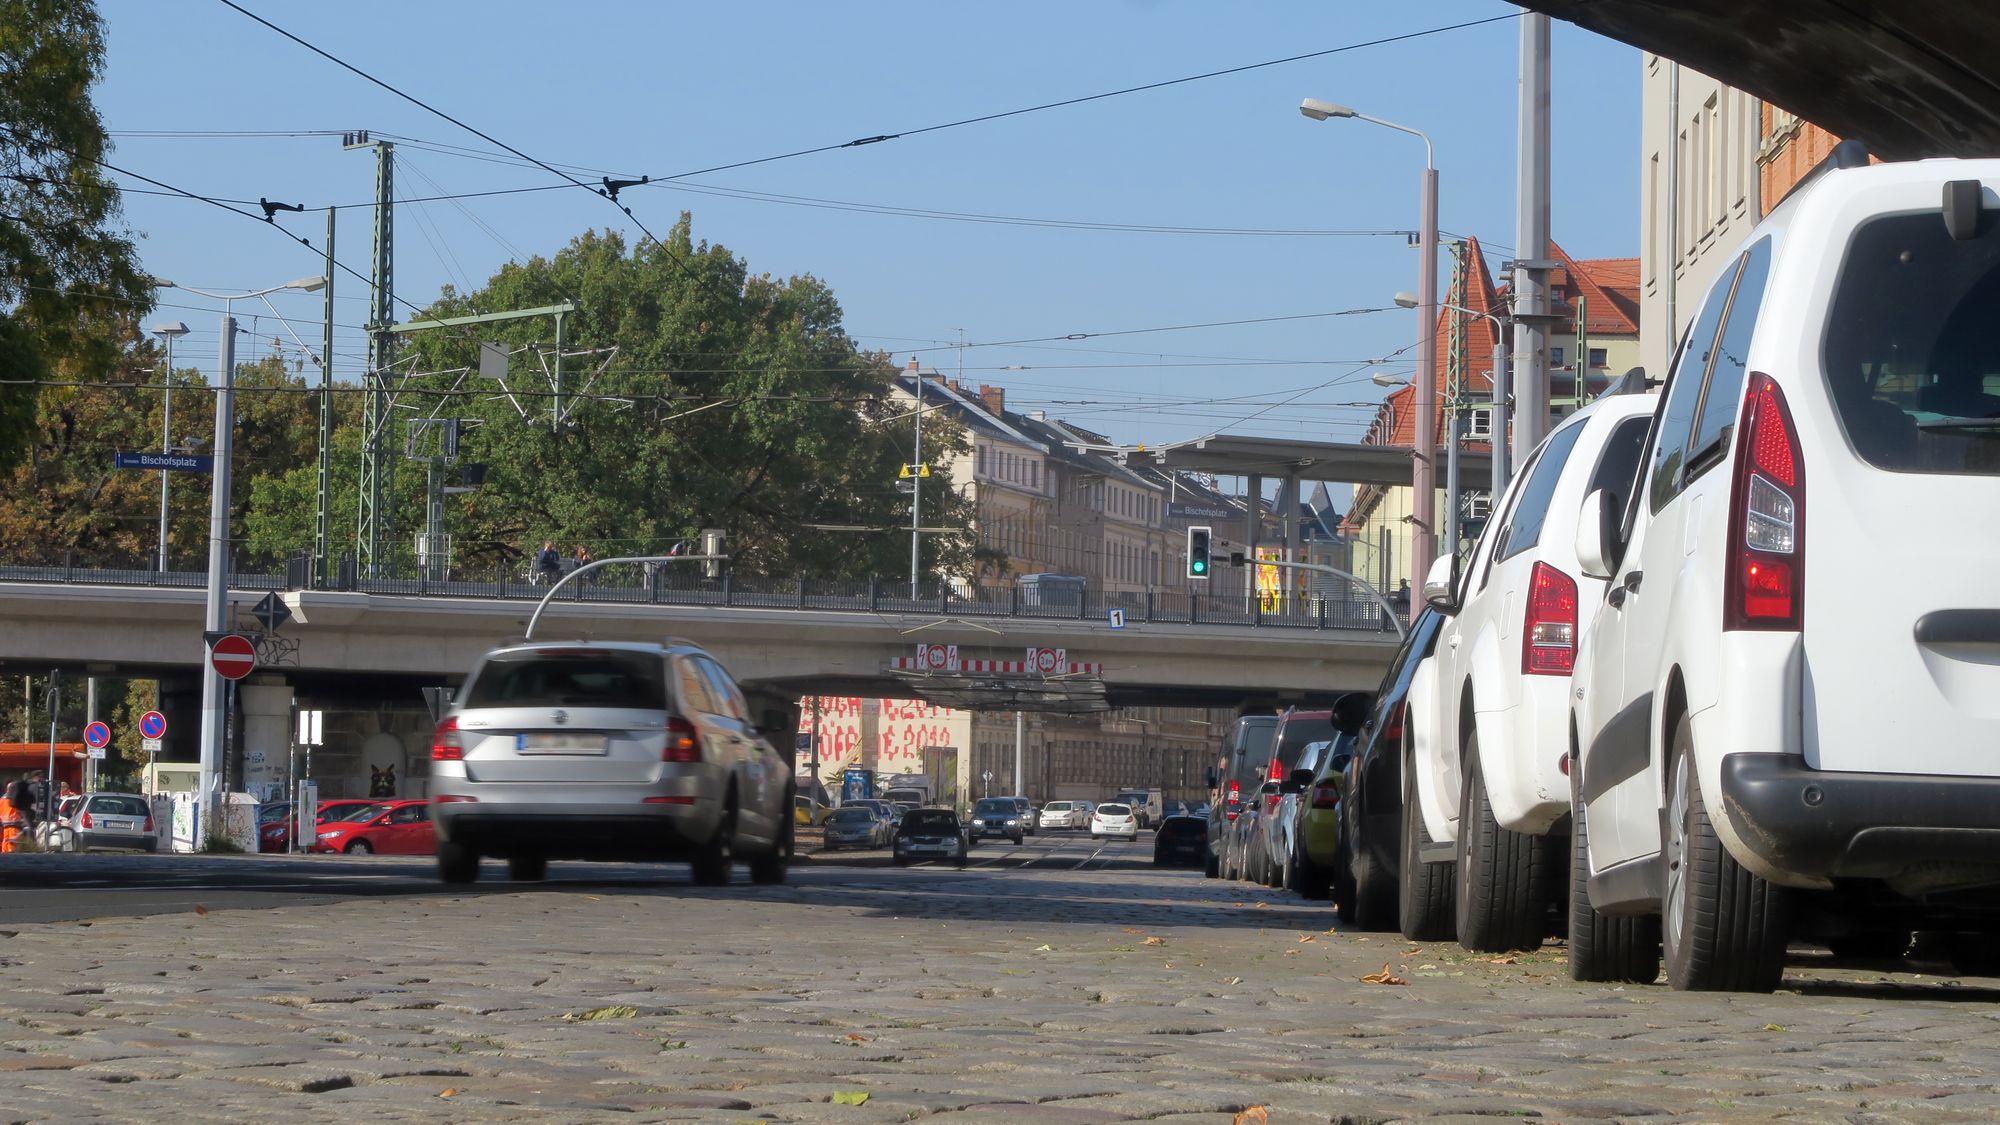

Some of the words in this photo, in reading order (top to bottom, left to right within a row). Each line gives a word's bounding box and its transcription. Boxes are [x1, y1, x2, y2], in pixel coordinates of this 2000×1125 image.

[141, 455, 197, 467] Bischofsplatz
[1185, 506, 1228, 518] Bischofsplatz
[1113, 611, 1121, 626] 1
